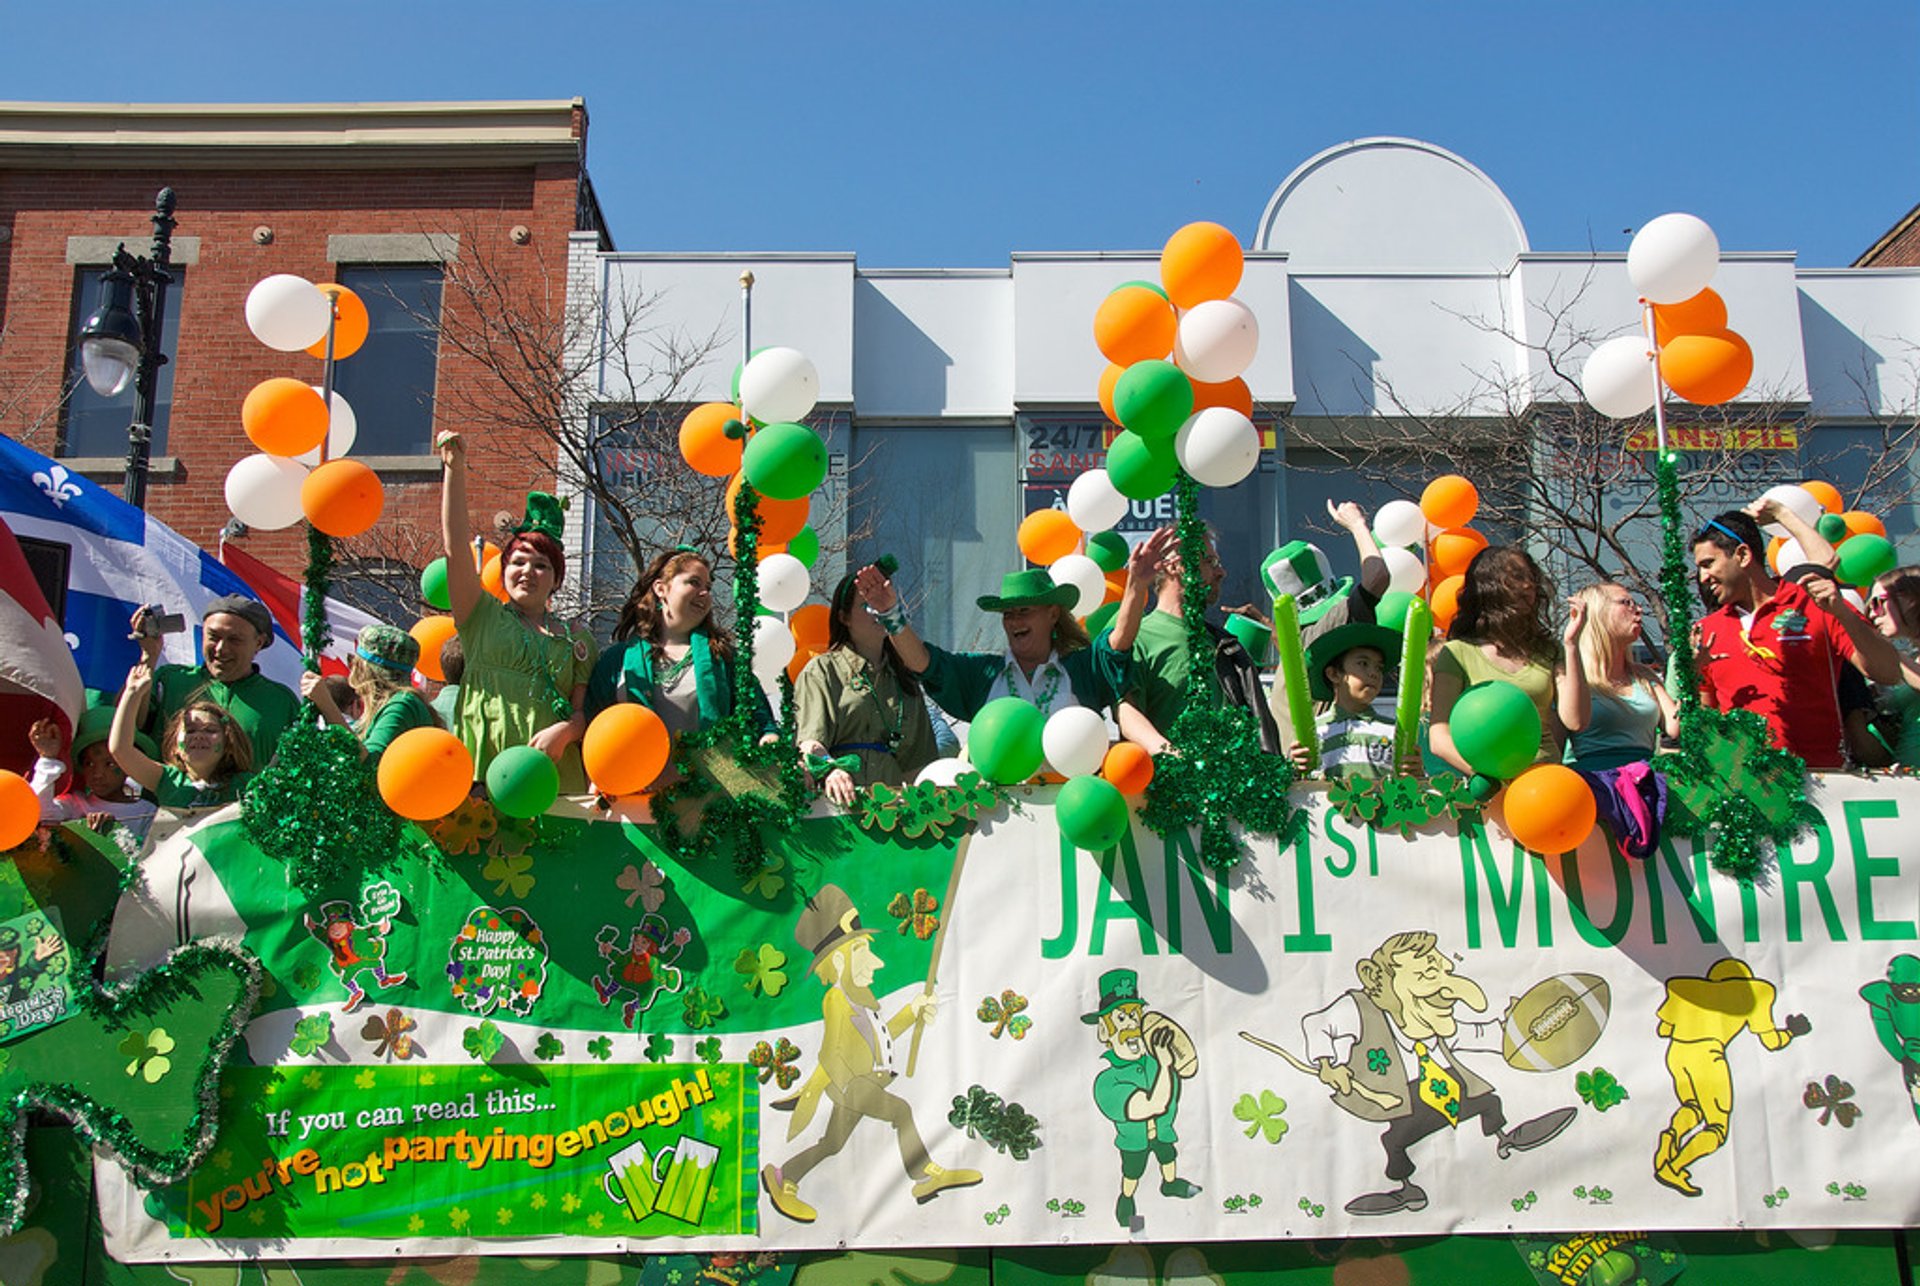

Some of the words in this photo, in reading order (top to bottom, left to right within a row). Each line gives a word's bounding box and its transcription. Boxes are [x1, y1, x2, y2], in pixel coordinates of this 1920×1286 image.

[1028, 425, 1101, 449] 24/7
[1041, 820, 1234, 959] JAN
[476, 929, 519, 945] Happy
[482, 963, 511, 980] Day!
[265, 1110, 291, 1137] If
[298, 1111, 347, 1140] you
[355, 1104, 404, 1128] can
[412, 1092, 479, 1122] read
[485, 1087, 556, 1116] this...
[195, 1147, 321, 1233] you're
[314, 1151, 386, 1195] not
[383, 1126, 556, 1170] partying
[555, 1068, 715, 1158] enough!
